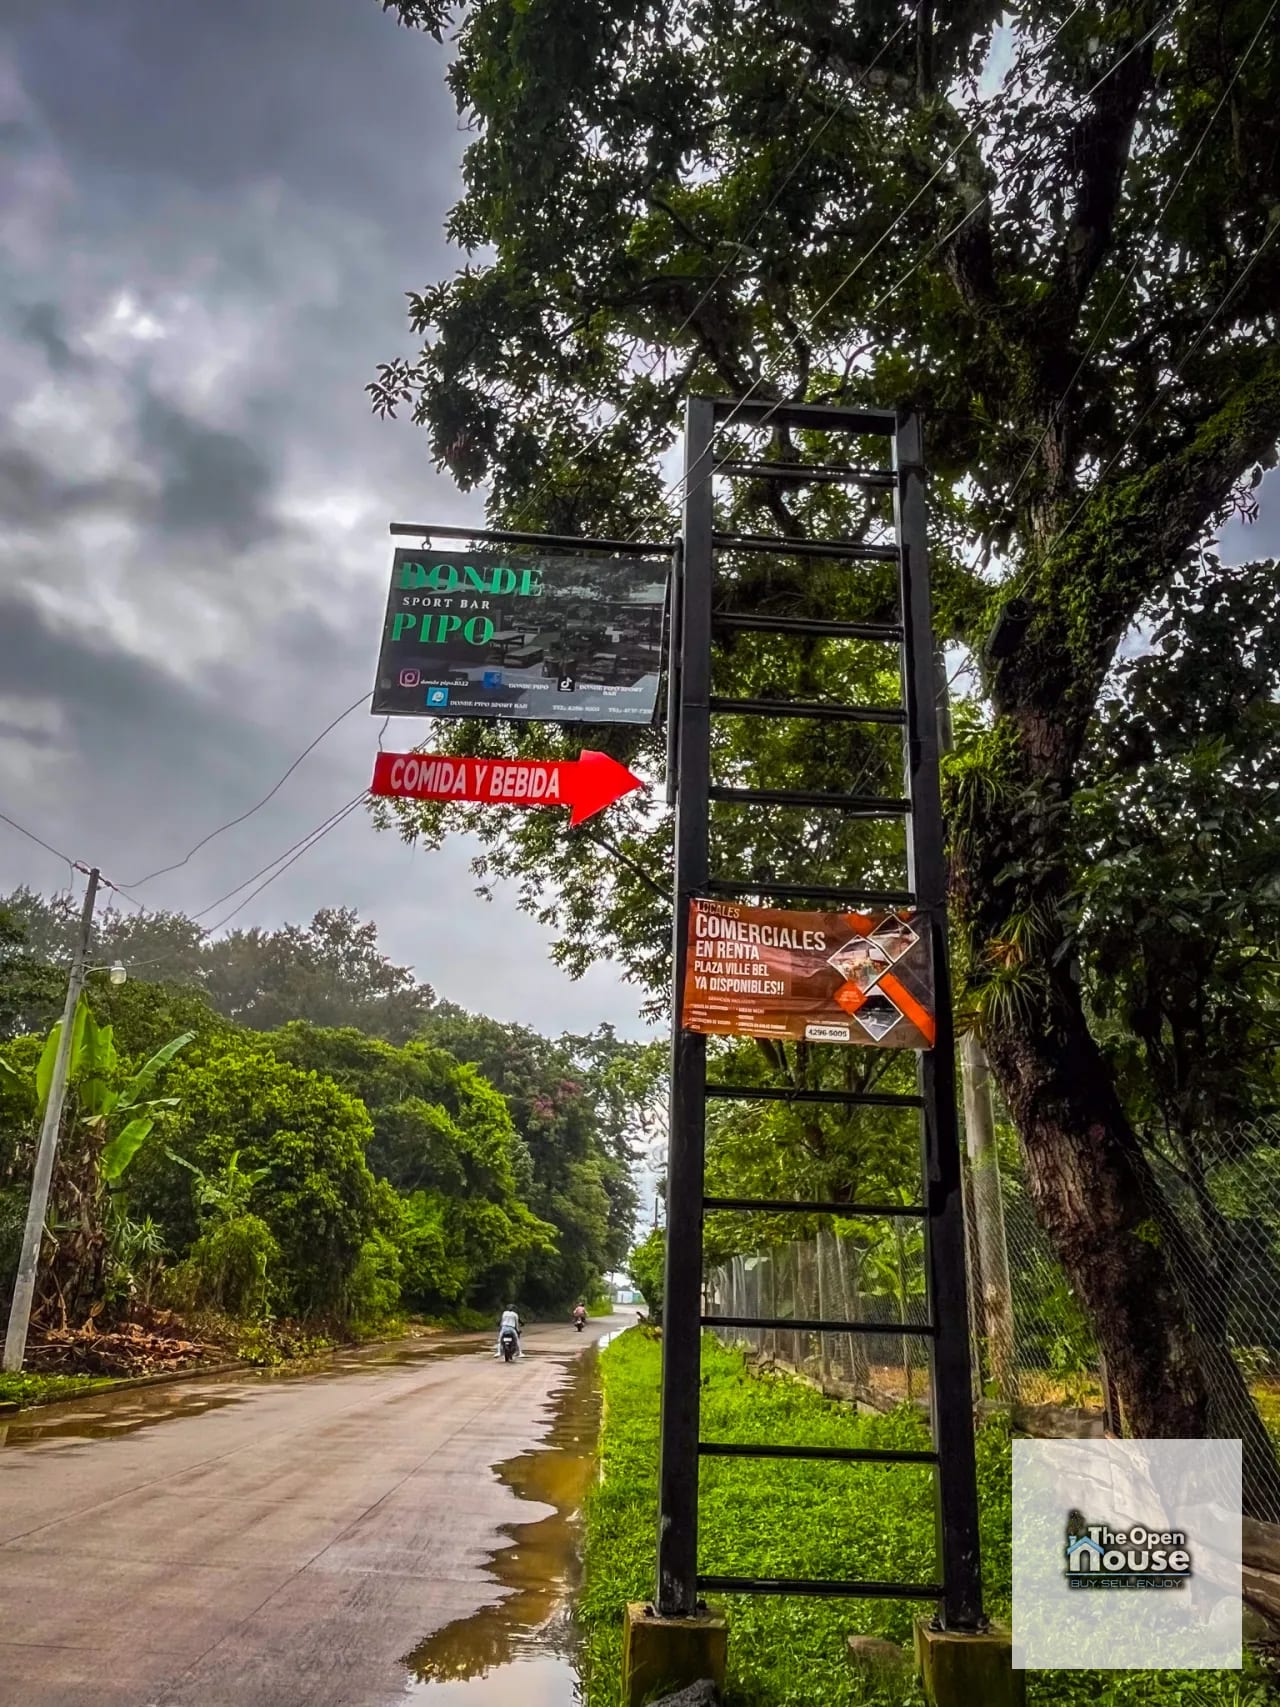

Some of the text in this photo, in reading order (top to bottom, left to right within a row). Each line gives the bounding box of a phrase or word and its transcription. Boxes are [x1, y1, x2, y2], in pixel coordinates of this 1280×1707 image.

[400, 562, 543, 597] DONDE
[403, 597, 490, 610] SPORT BAR
[391, 612, 495, 645] PIPO
[390, 759, 560, 798] COMIDA Y BEBIDA
[696, 902, 740, 919] LOCALES
[695, 914, 826, 951] COMERCIALES
[696, 940, 759, 960] EN RENTA
[694, 960, 769, 977] PLAZA VILLE BEL
[694, 976, 784, 995] YA DISPONIBLES!!
